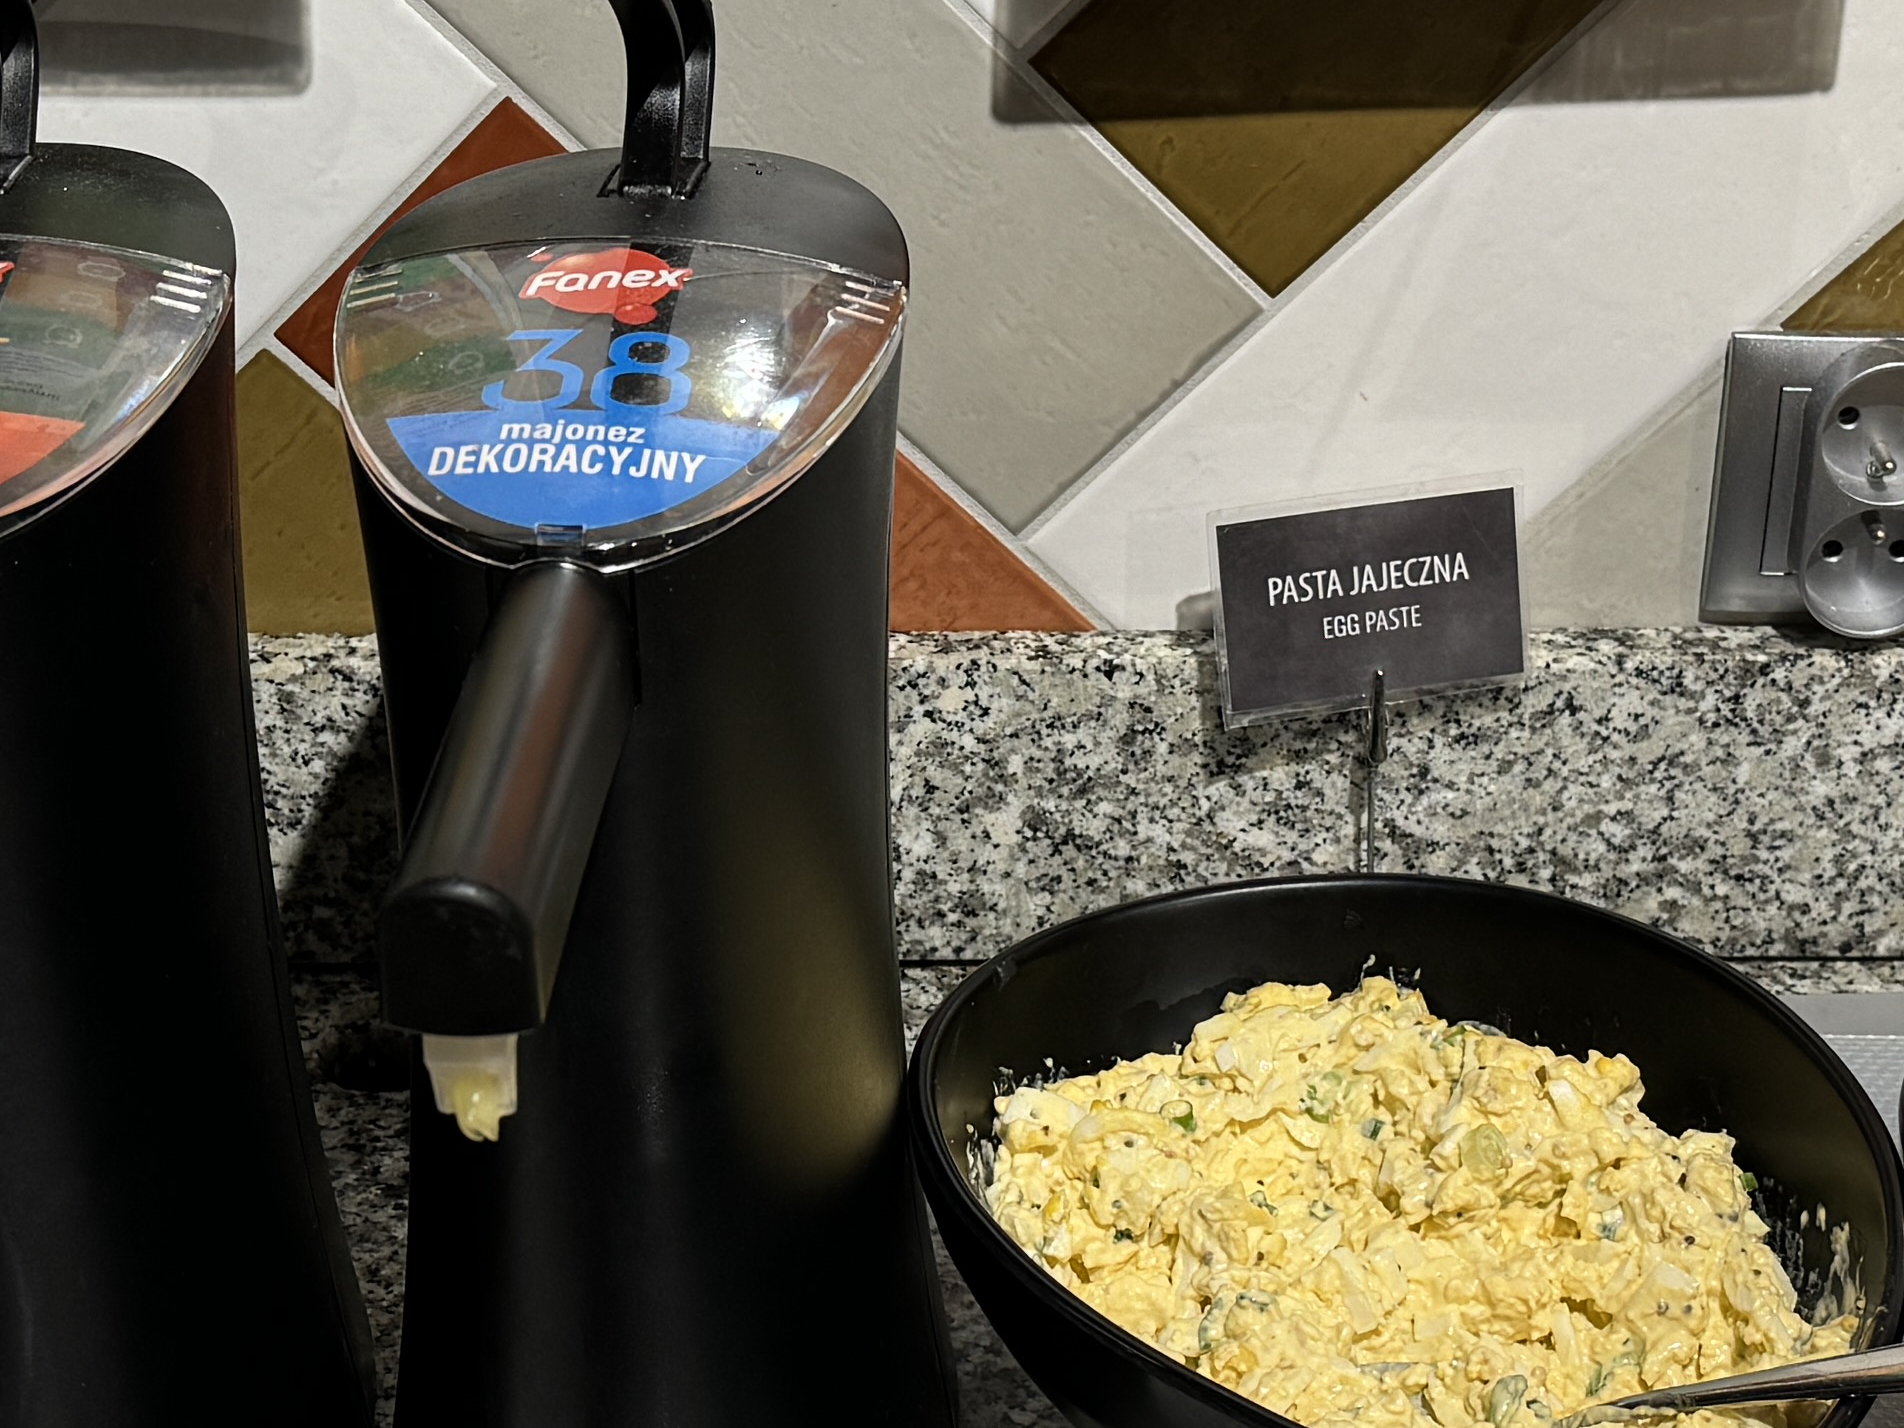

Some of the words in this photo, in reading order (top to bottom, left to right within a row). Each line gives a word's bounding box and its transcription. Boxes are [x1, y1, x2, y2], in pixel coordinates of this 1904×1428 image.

[524, 264, 688, 298] Fanex
[480, 328, 691, 415] 38
[499, 419, 646, 445] majonez
[427, 444, 707, 484] DEKORACYJNY
[1268, 569, 1344, 606] PASTA
[1350, 552, 1469, 595] JAJECZNA
[1323, 614, 1360, 639] EGG
[1365, 605, 1422, 633] PASTE
